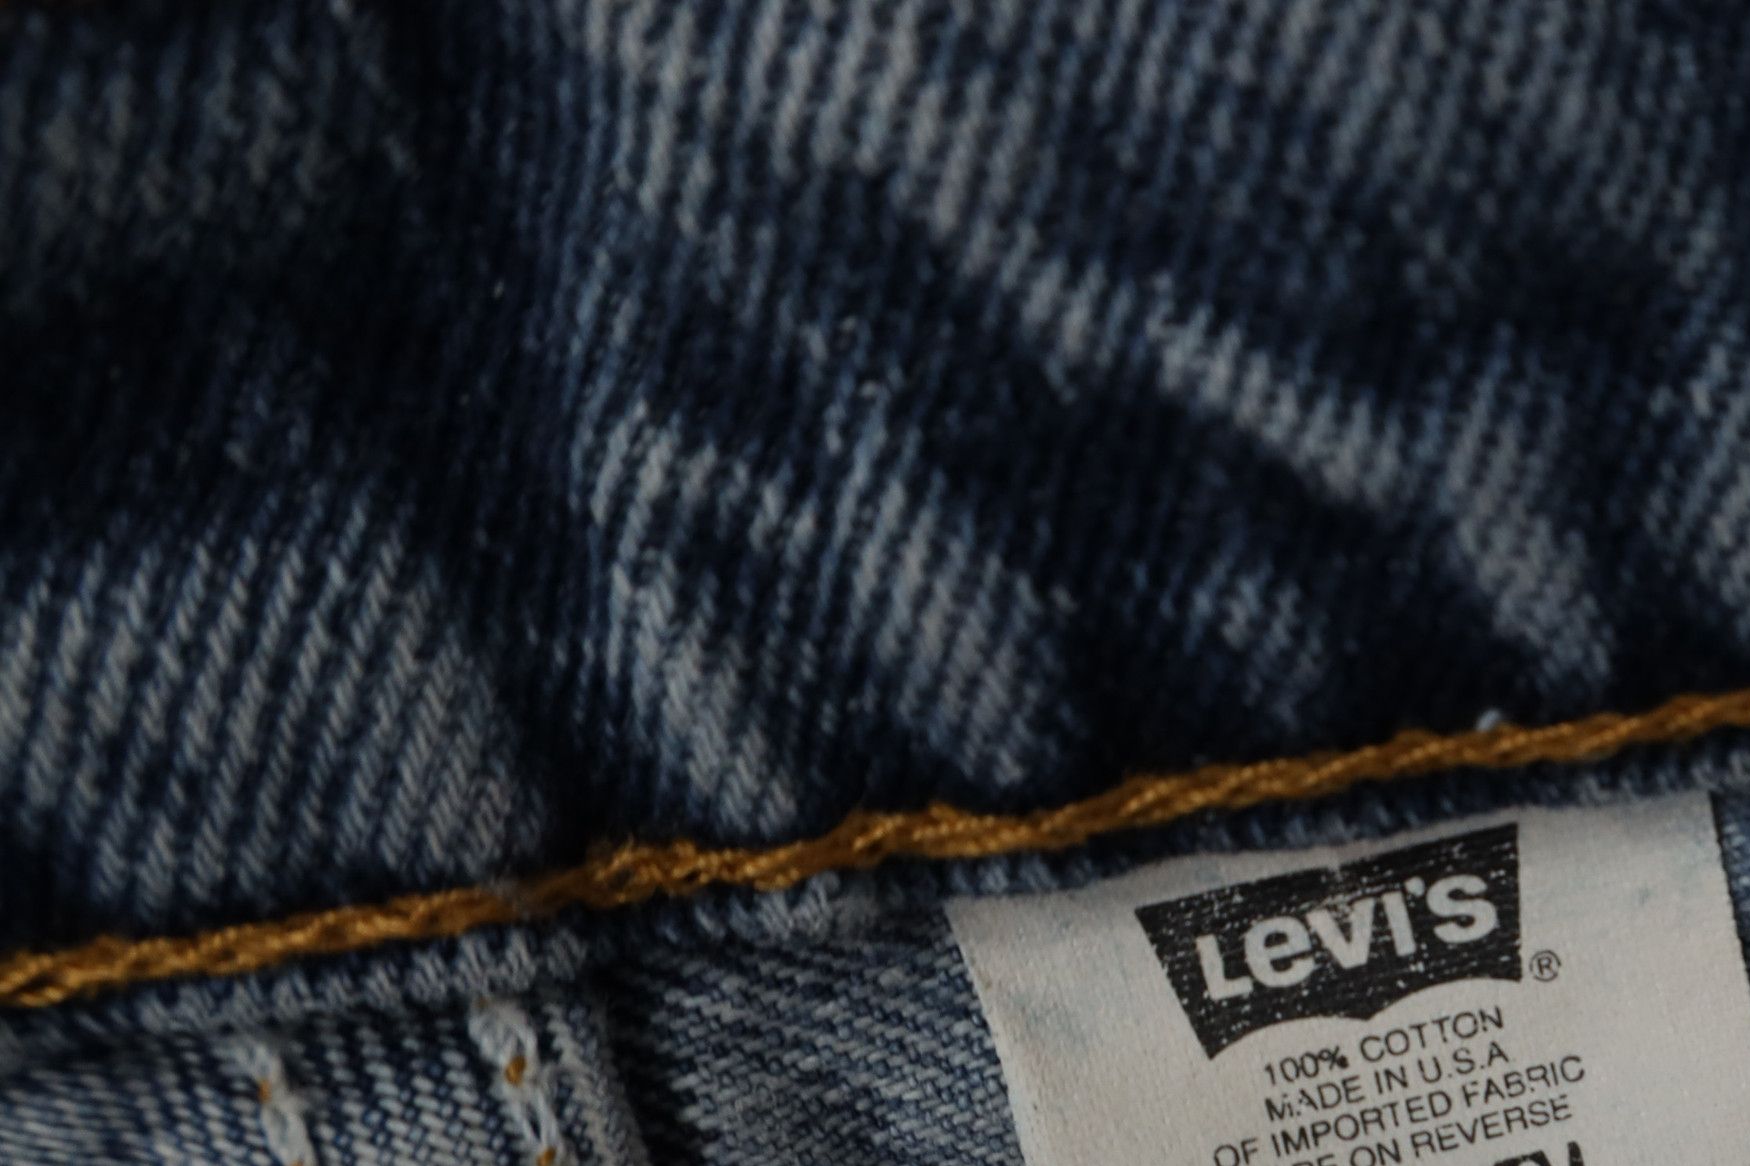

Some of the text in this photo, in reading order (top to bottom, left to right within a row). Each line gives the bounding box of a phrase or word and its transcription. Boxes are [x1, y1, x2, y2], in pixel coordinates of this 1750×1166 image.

[1264, 1007, 1504, 1085] 100% COTTON
[1265, 1077, 1366, 1122] MADE
[1375, 1066, 1412, 1093] IN
[1271, 1091, 1452, 1157] IMPORTED
[1461, 1055, 1585, 1107] FABRIC
[1411, 1095, 1572, 1157] REVERSE
